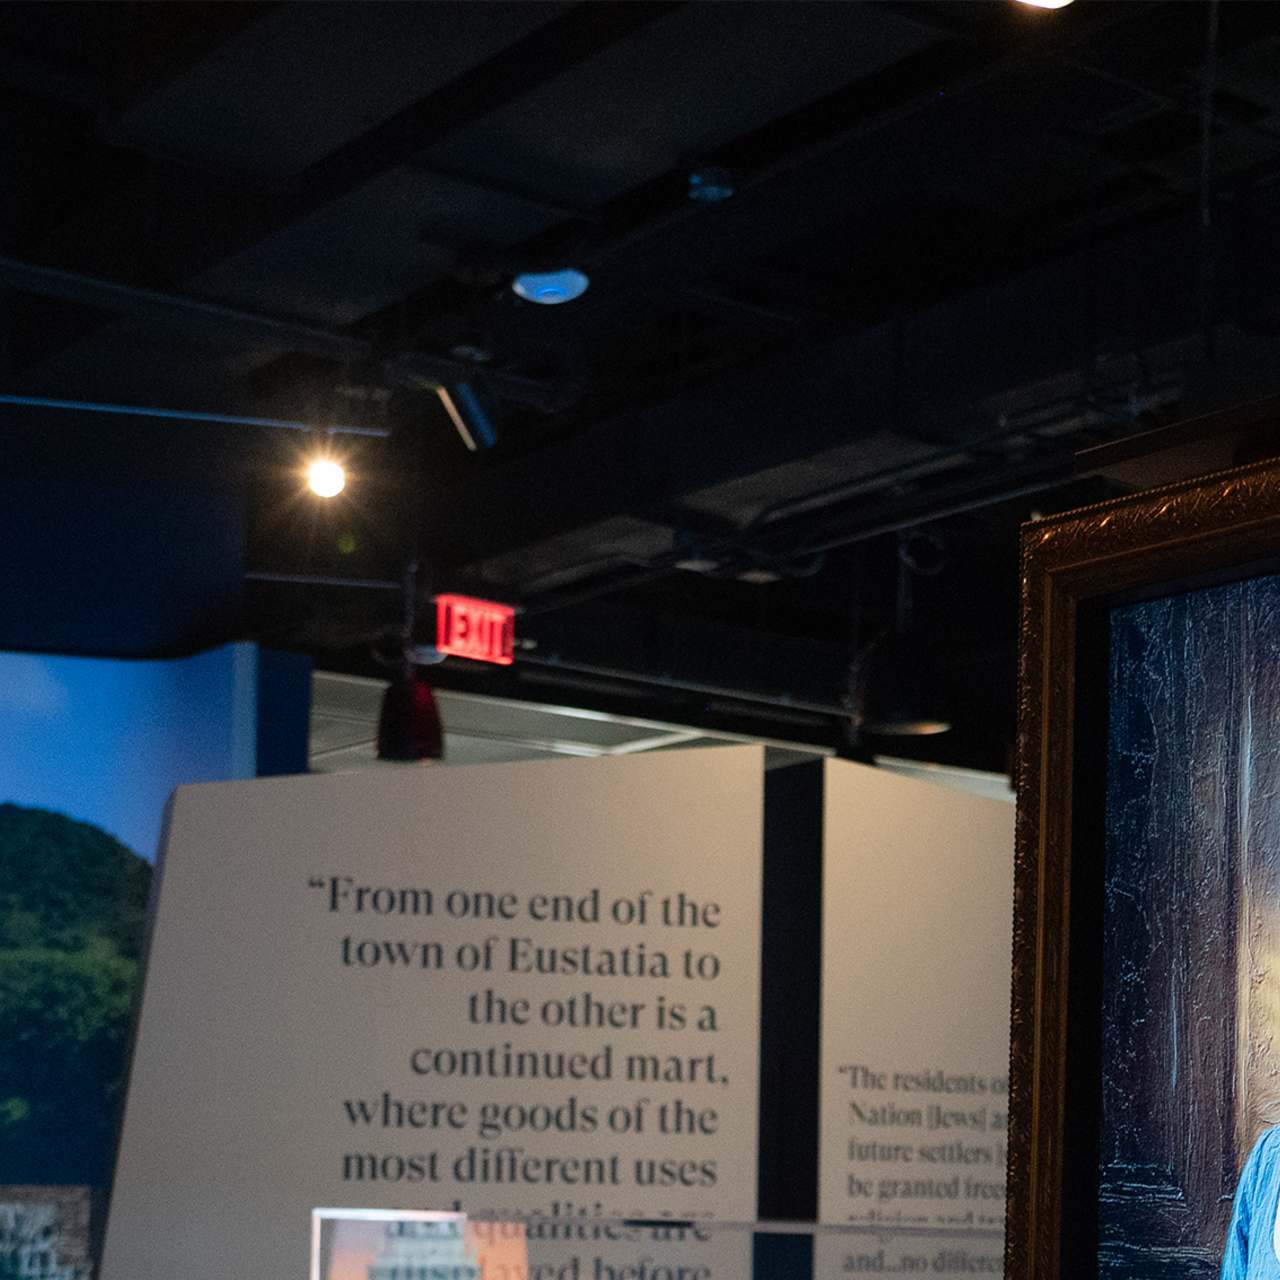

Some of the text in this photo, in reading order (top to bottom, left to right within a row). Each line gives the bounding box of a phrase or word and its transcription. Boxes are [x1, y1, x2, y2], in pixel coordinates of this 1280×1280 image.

[451, 603, 509, 657] EXIT
[308, 875, 721, 928] “From one end of the
[341, 936, 721, 980] town of Eustatia to
[468, 988, 719, 1032] the other is a
[409, 1042, 613, 1081] continued
[893, 1070, 988, 1094] residents
[343, 1091, 718, 1140] where goods of the
[850, 1102, 923, 1126] Nation
[342, 1146, 718, 1188] most different uses
[848, 1137, 913, 1162] future
[918, 1141, 992, 1165] settlers
[848, 1174, 873, 1198] be
[878, 1174, 959, 1201] granted
